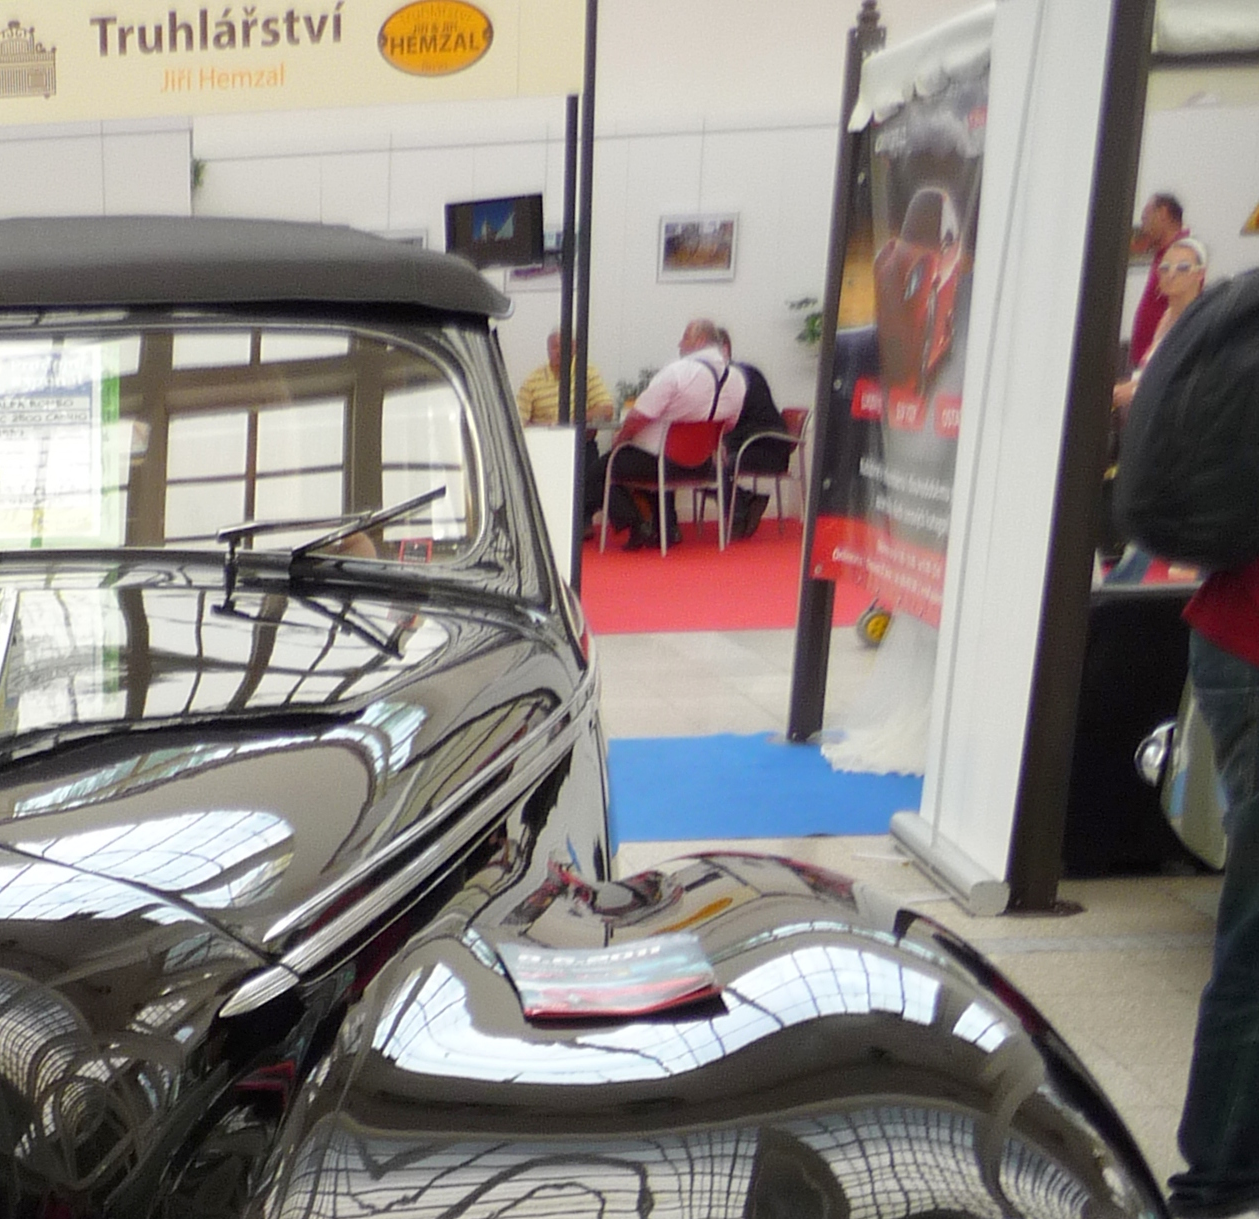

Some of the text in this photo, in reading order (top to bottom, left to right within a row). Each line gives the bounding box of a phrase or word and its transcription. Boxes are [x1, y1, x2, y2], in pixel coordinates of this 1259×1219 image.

[89, 1, 344, 57] Truhlářství
[390, 32, 480, 56] HEMZAL
[160, 61, 286, 94] Jiří Hemzal
